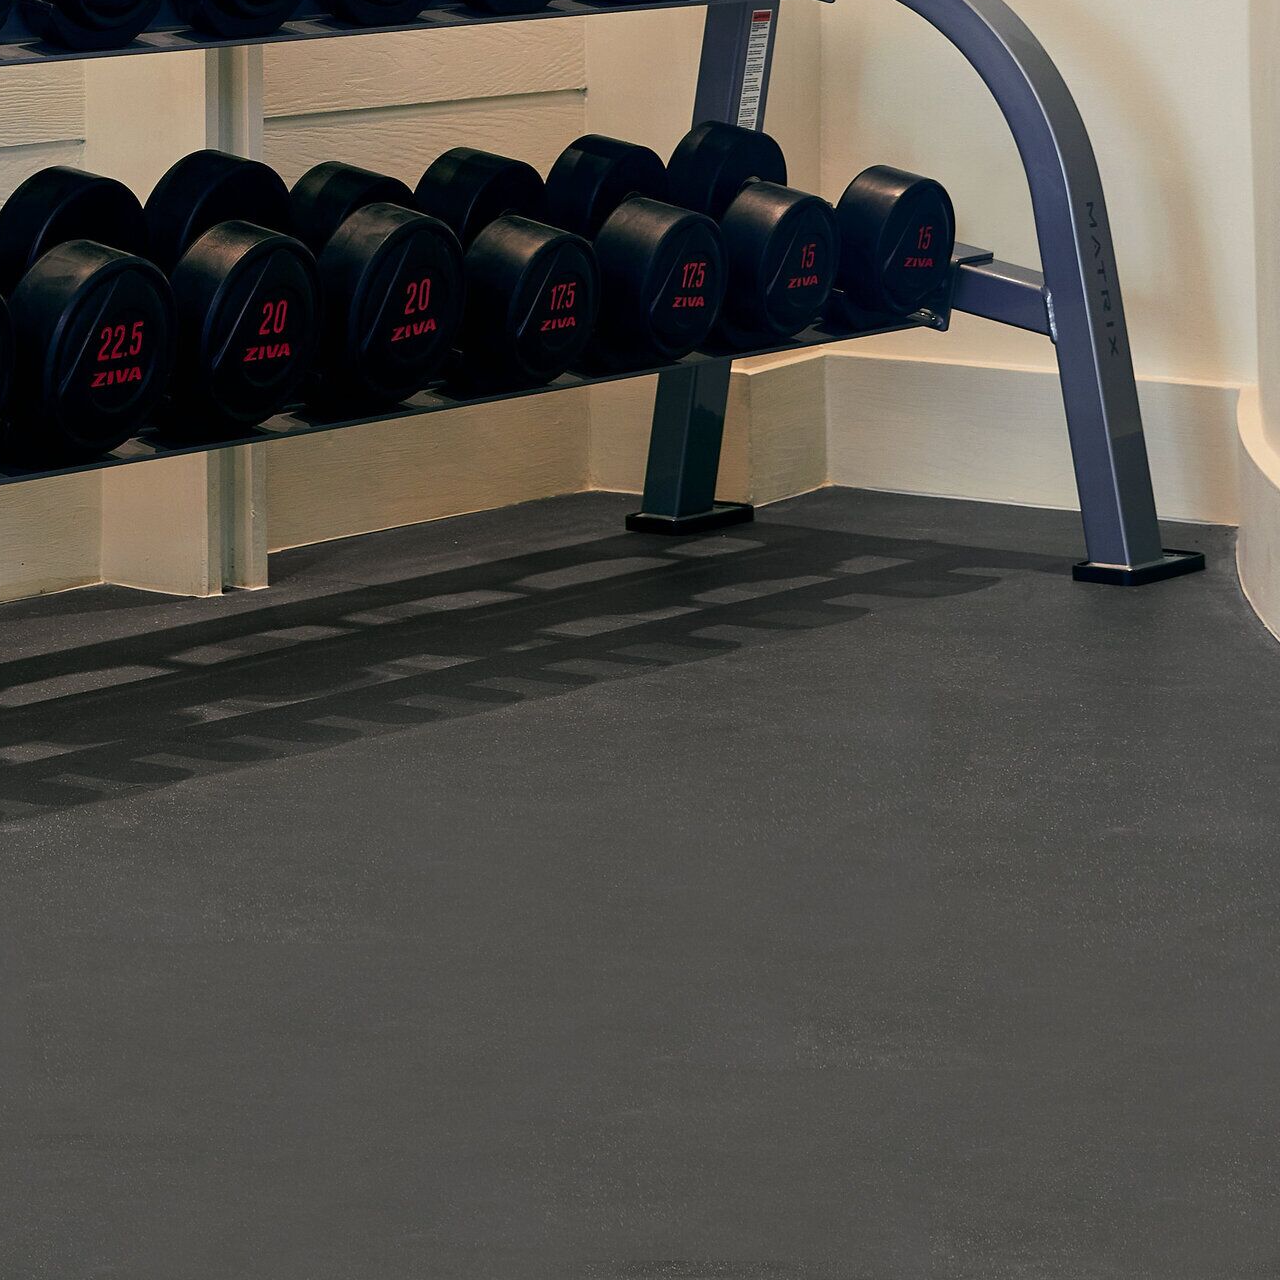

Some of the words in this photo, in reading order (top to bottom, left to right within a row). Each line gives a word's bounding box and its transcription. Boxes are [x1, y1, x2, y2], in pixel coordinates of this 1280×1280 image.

[917, 226, 933, 251] 15
[800, 243, 816, 269] 15
[903, 256, 935, 268] ZIVA
[681, 263, 707, 289] 17.5
[787, 274, 819, 289] ZIVA
[1086, 201, 1120, 357] MATRIX
[404, 278, 432, 315] 20
[550, 282, 577, 311] 17.5
[672, 296, 705, 308] ZIVA
[258, 299, 289, 336] 20
[391, 318, 437, 342] ZIVA
[540, 316, 577, 332] ZIVA
[97, 321, 144, 362] 22.5
[243, 342, 291, 362] ZIVA
[90, 366, 142, 388] ZIVA
